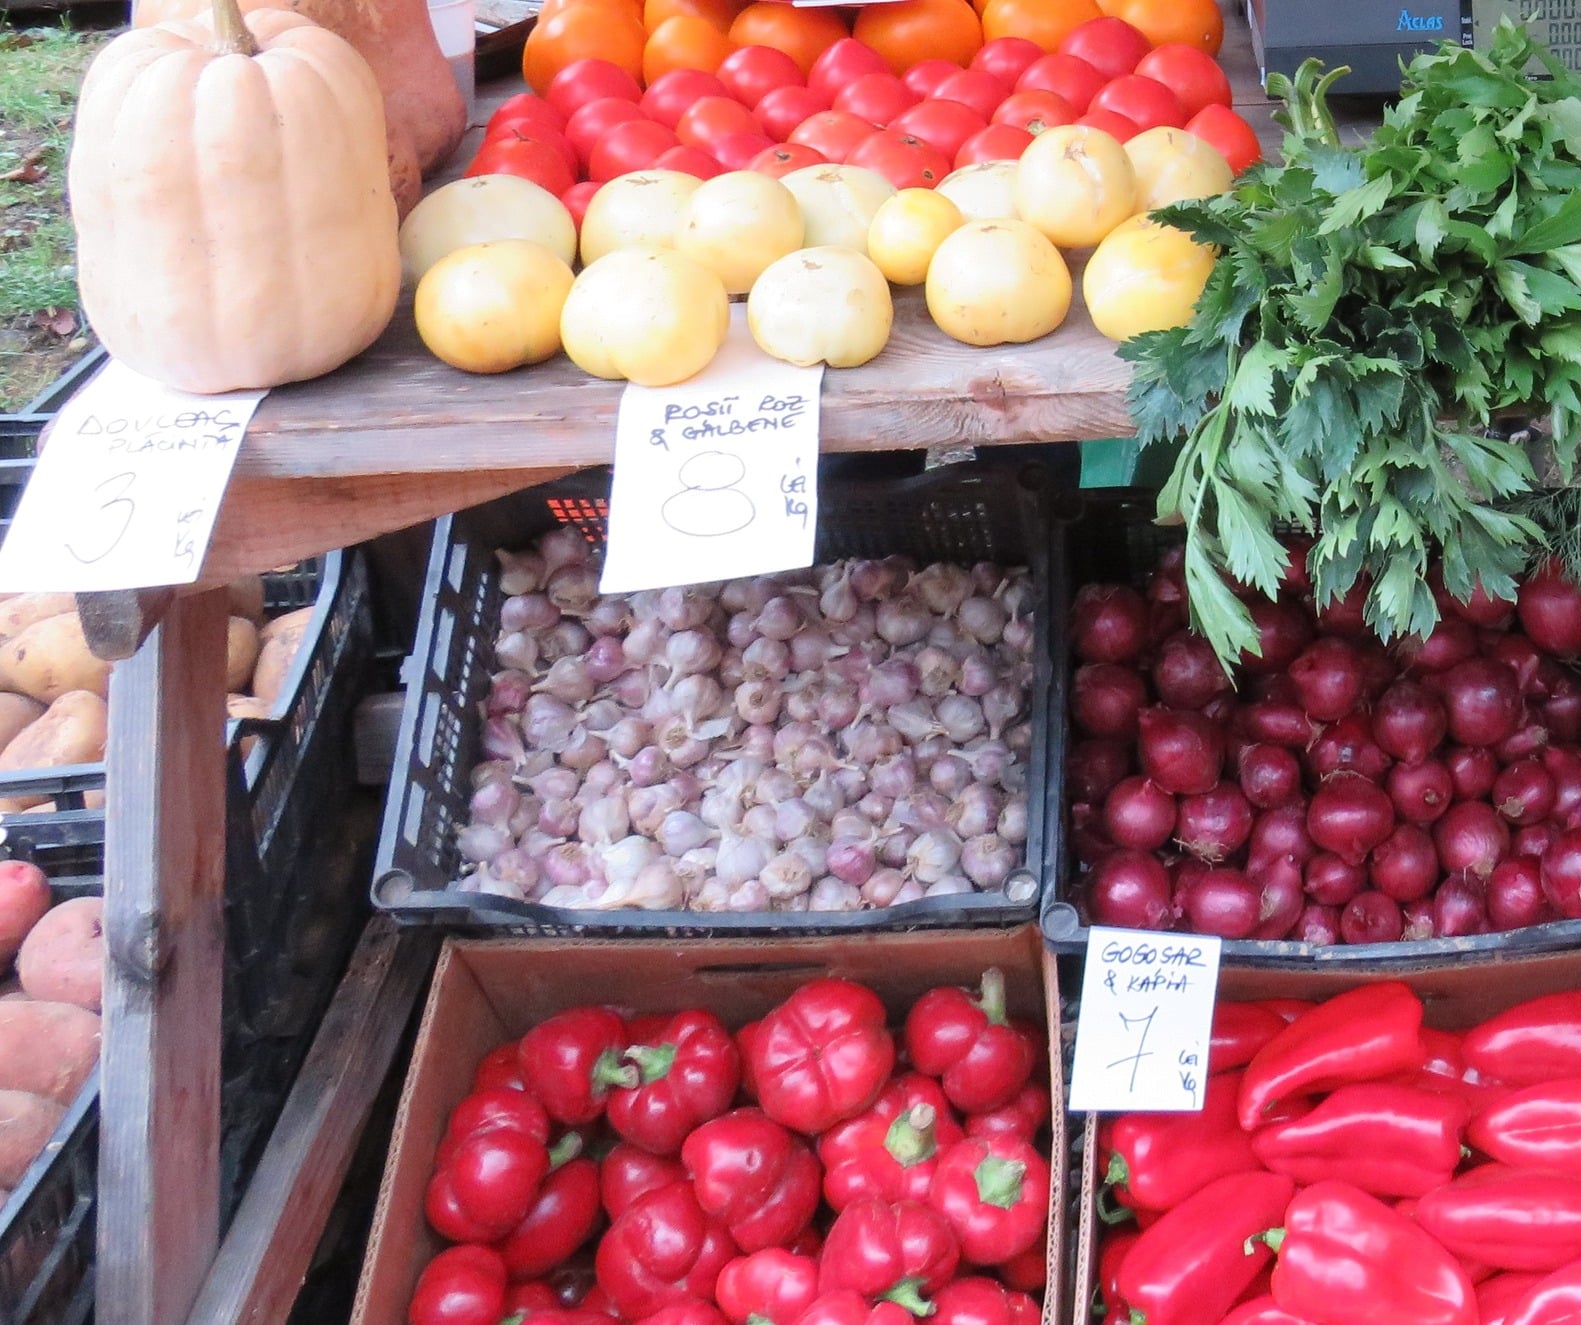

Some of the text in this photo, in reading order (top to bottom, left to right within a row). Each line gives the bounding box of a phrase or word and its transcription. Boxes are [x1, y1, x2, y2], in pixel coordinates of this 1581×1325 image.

[64, 471, 137, 565] 3
[661, 450, 756, 537] 8
[1103, 969, 1118, 996] &
[1106, 1005, 1159, 1093] 7
